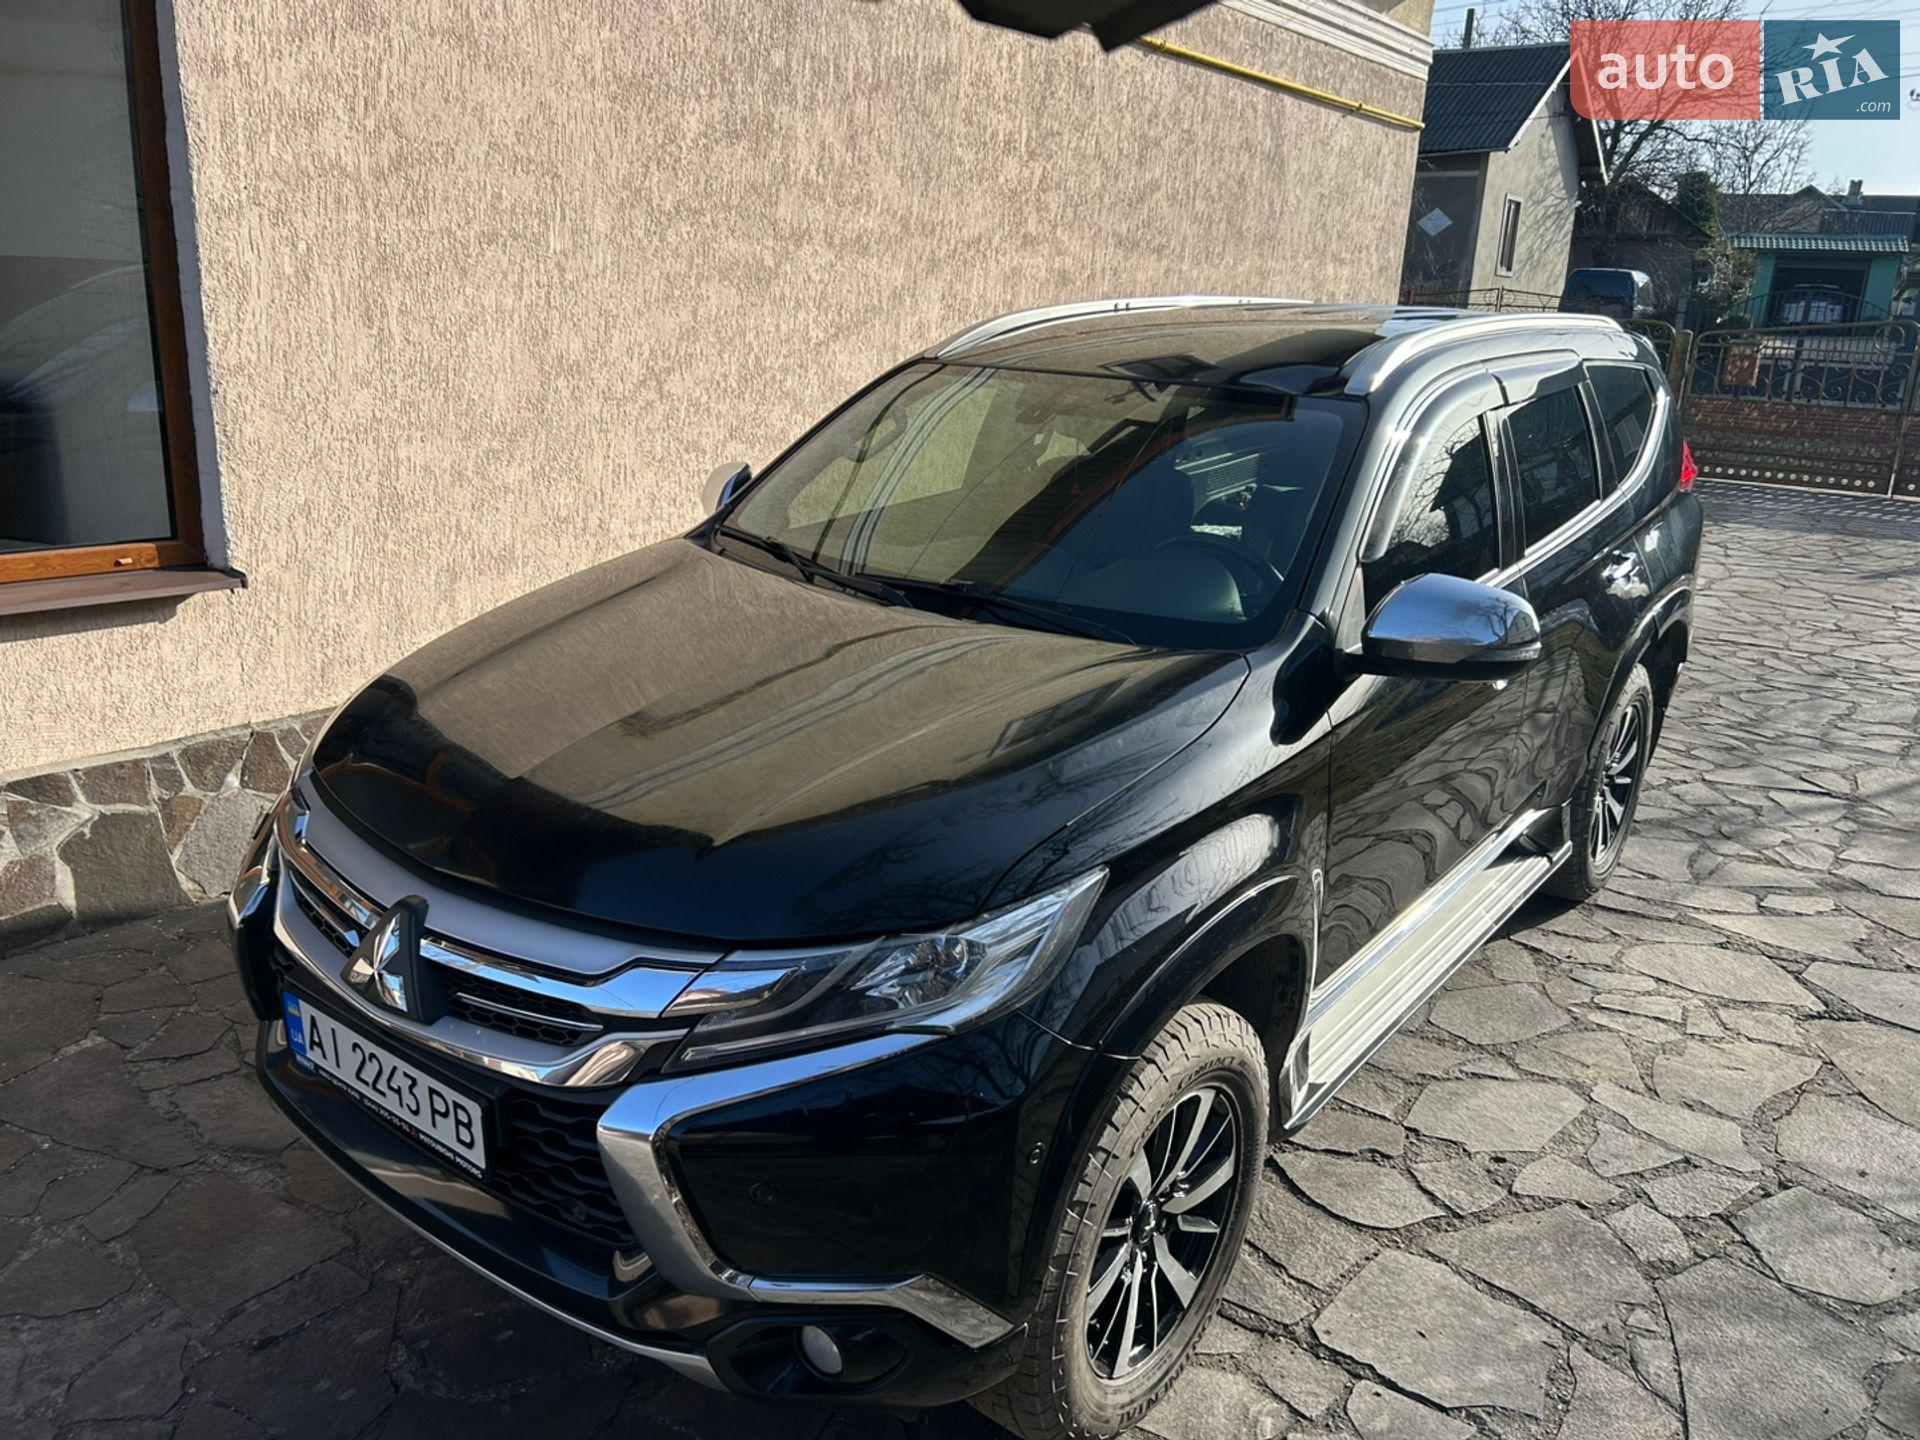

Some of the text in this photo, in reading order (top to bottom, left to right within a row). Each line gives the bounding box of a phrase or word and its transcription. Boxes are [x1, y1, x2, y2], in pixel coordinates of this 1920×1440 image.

[290, 1028, 305, 1047] UA
[309, 1013, 340, 1069] AI
[352, 1042, 420, 1116] 2243
[428, 1086, 475, 1150] PB
